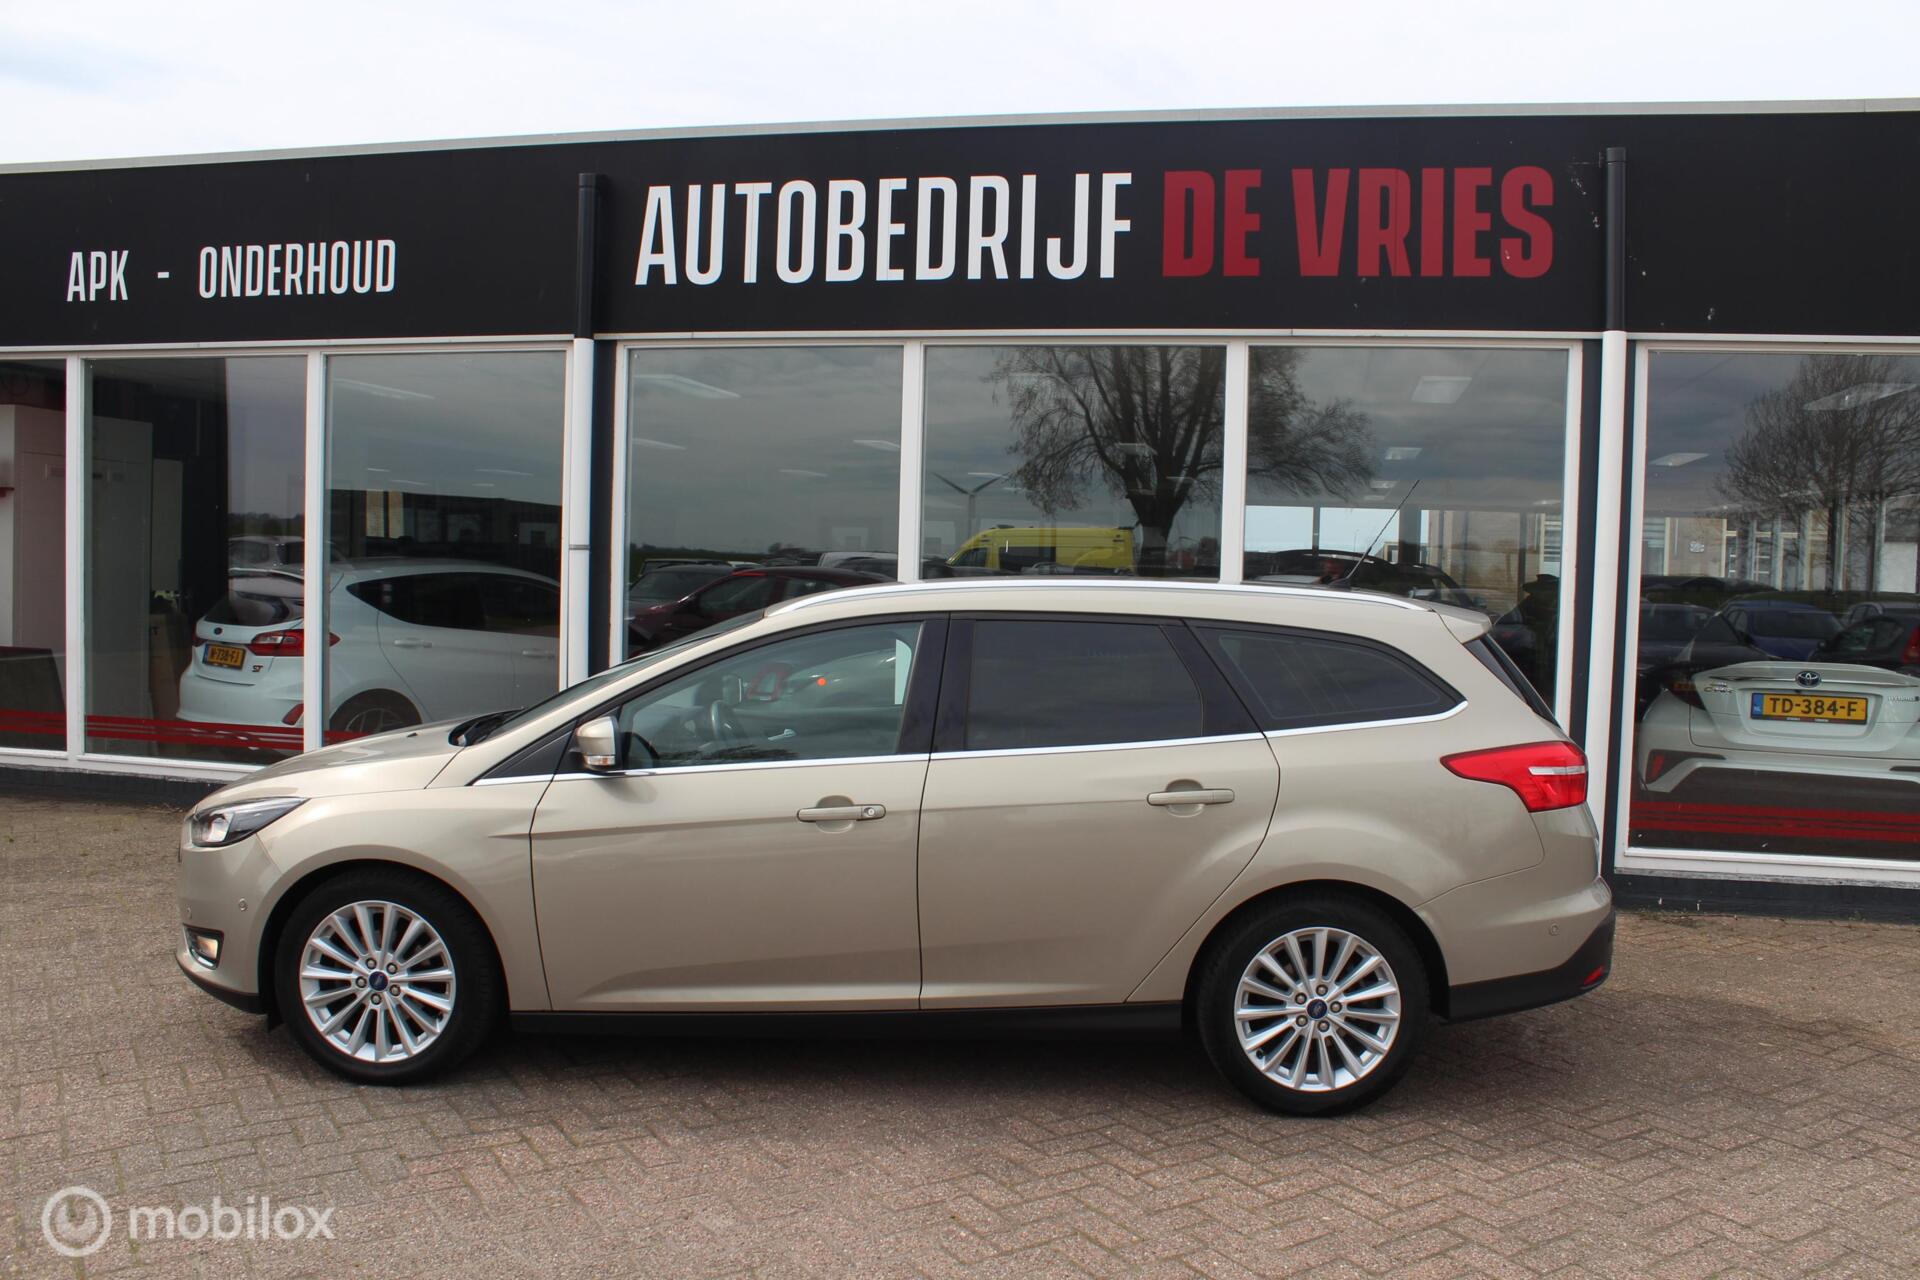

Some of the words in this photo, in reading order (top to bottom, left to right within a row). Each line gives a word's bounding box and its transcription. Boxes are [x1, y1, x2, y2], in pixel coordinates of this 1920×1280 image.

[635, 172, 1132, 285] AUTOBEDRIJF
[1162, 168, 1262, 278] DE
[1292, 165, 1554, 278] VRIES
[67, 249, 129, 302] APK
[157, 271, 170, 279] -
[199, 239, 396, 299] ONDERHOUD
[1769, 697, 1858, 717] TD-384-F
